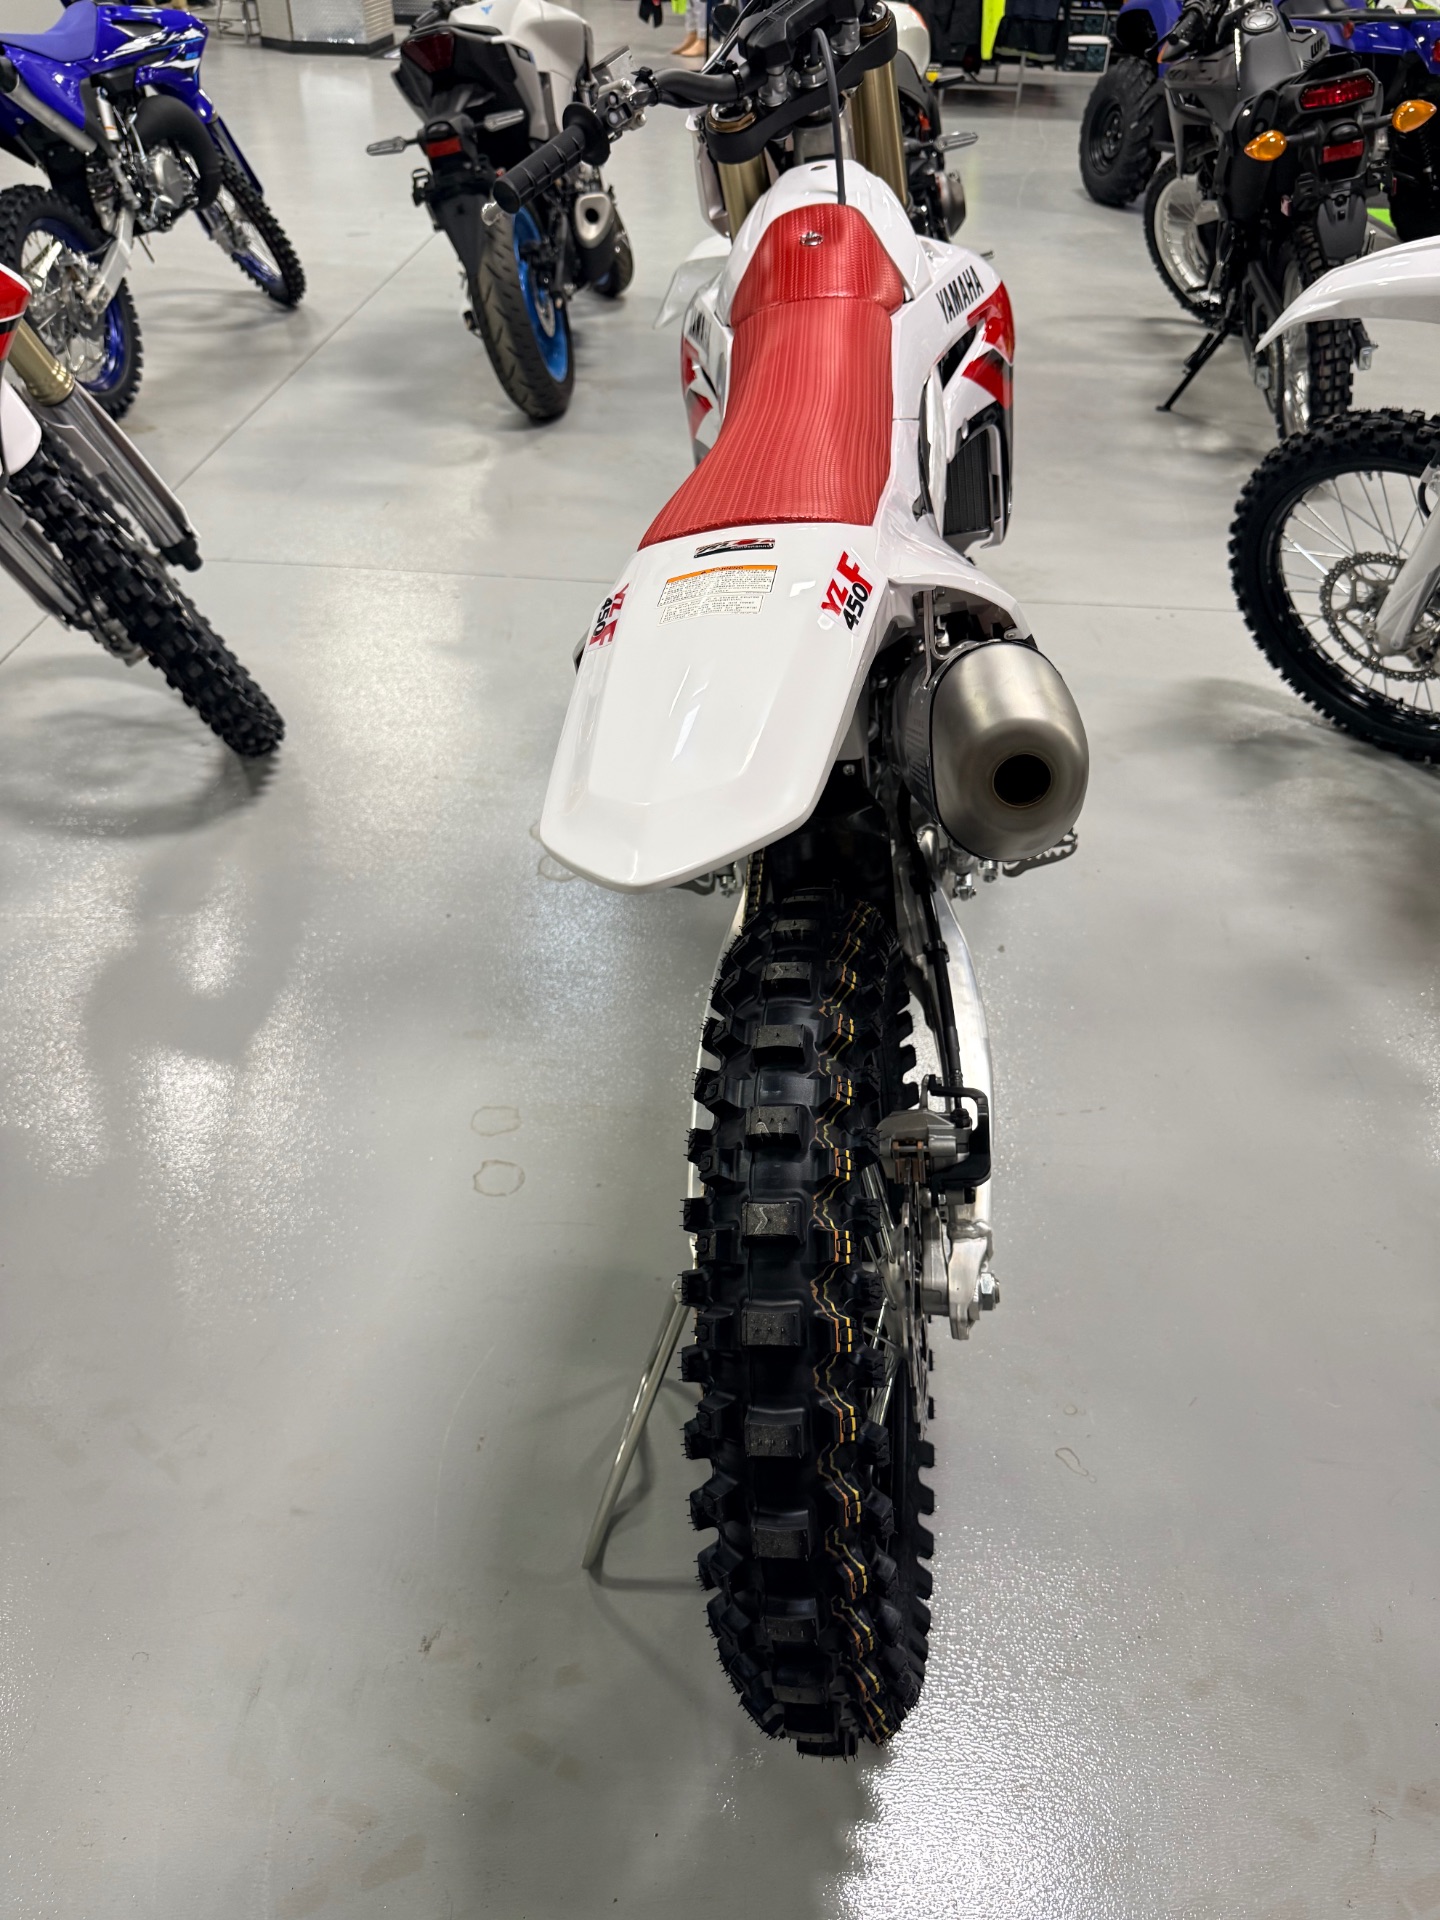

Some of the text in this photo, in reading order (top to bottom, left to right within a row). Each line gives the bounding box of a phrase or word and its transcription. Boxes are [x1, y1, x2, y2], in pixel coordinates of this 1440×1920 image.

[935, 265, 985, 325] YAMAHA
[820, 550, 873, 617] YZF
[843, 582, 869, 631] 450
[593, 597, 613, 637] 450
